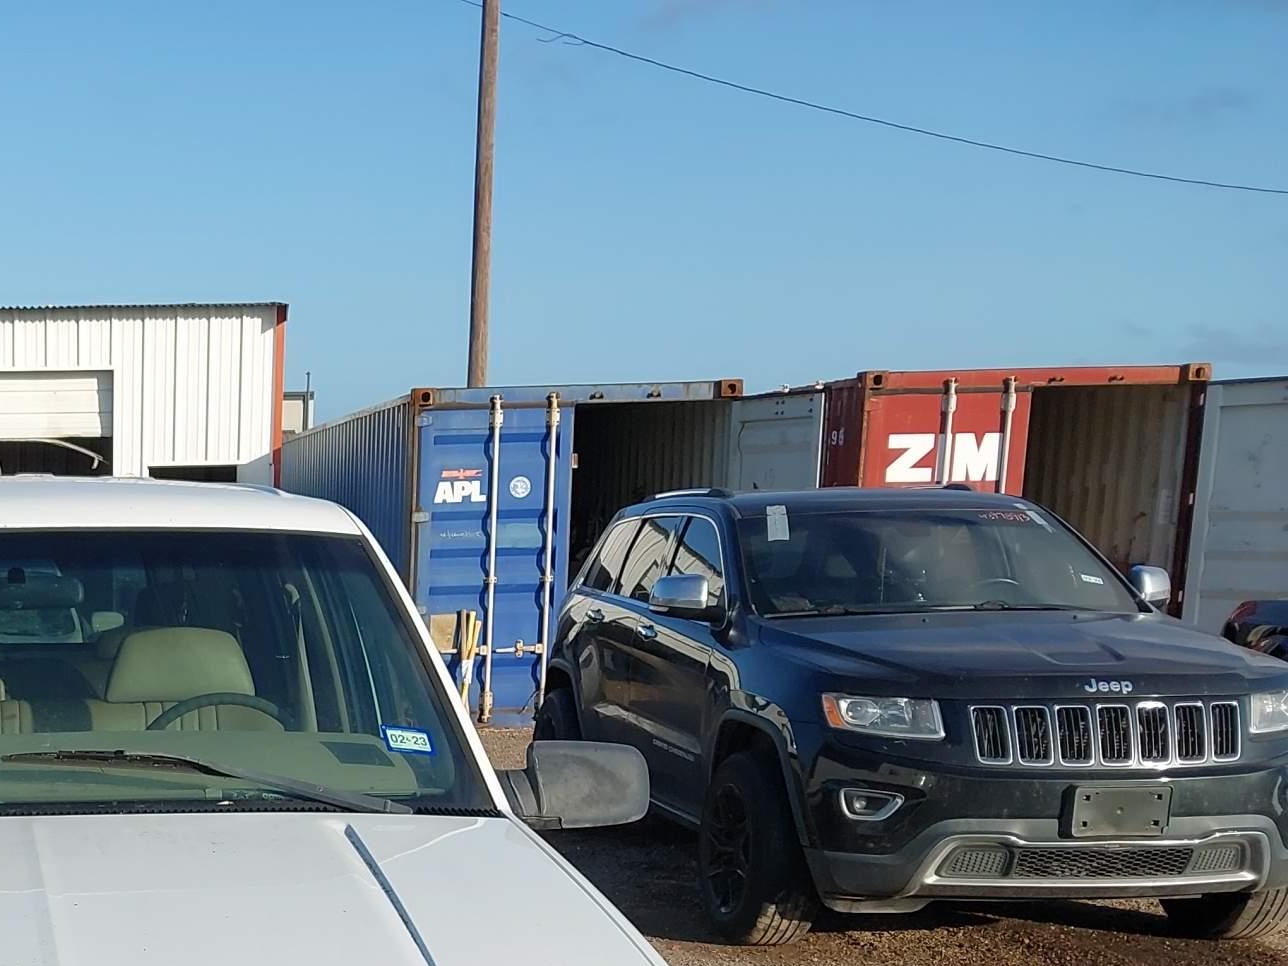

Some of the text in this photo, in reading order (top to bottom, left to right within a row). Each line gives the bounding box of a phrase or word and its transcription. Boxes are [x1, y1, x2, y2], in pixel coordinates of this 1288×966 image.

[885, 432, 1003, 483] ZIM
[433, 480, 487, 504] APL
[1084, 678, 1133, 695] Jeep
